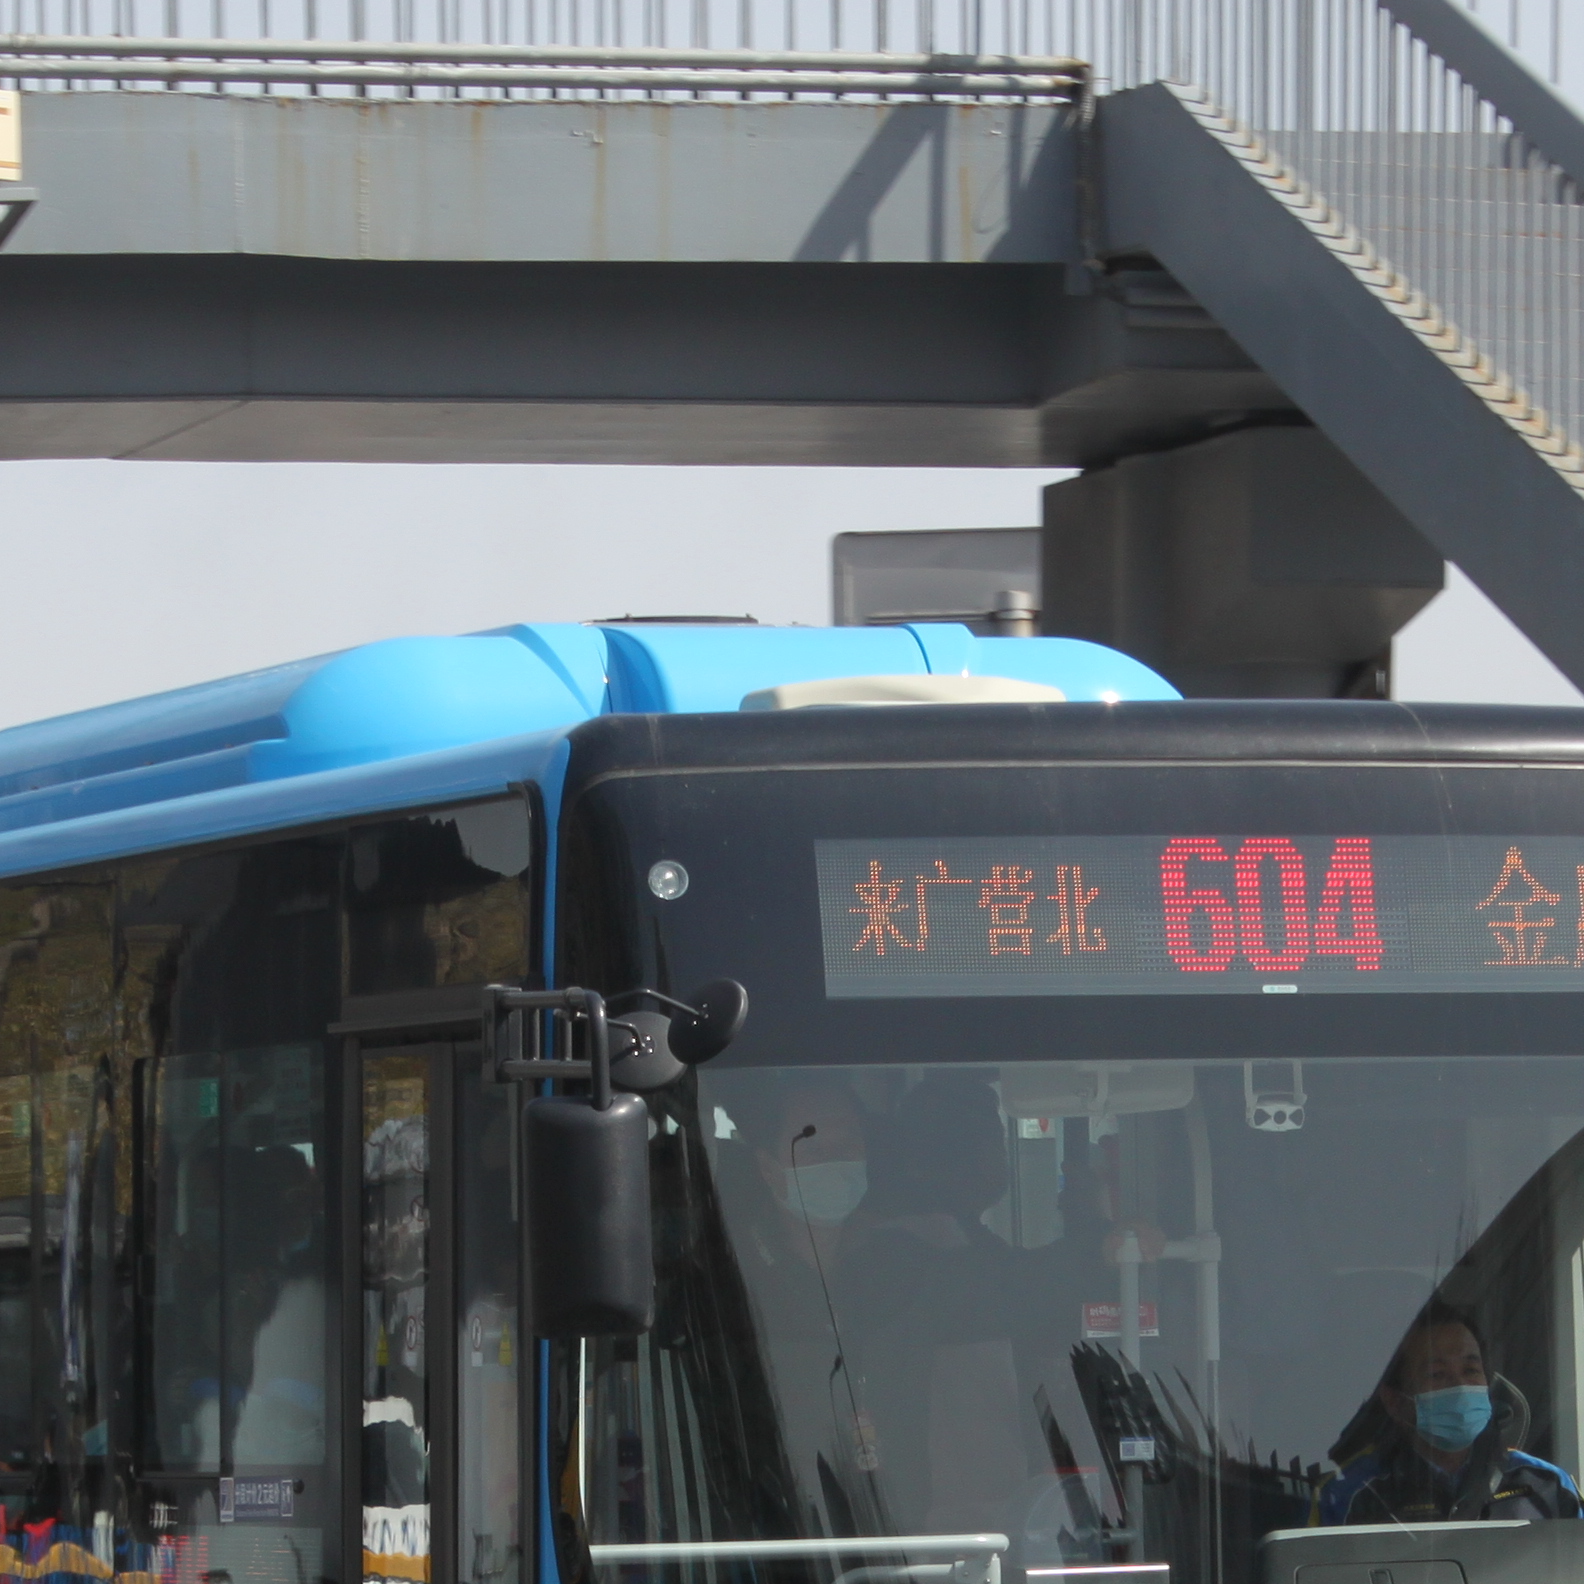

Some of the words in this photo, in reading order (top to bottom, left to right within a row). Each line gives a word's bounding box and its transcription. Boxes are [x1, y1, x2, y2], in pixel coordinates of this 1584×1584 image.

[848, 859, 1107, 956] 来广营北
[1160, 837, 1384, 972] 604
